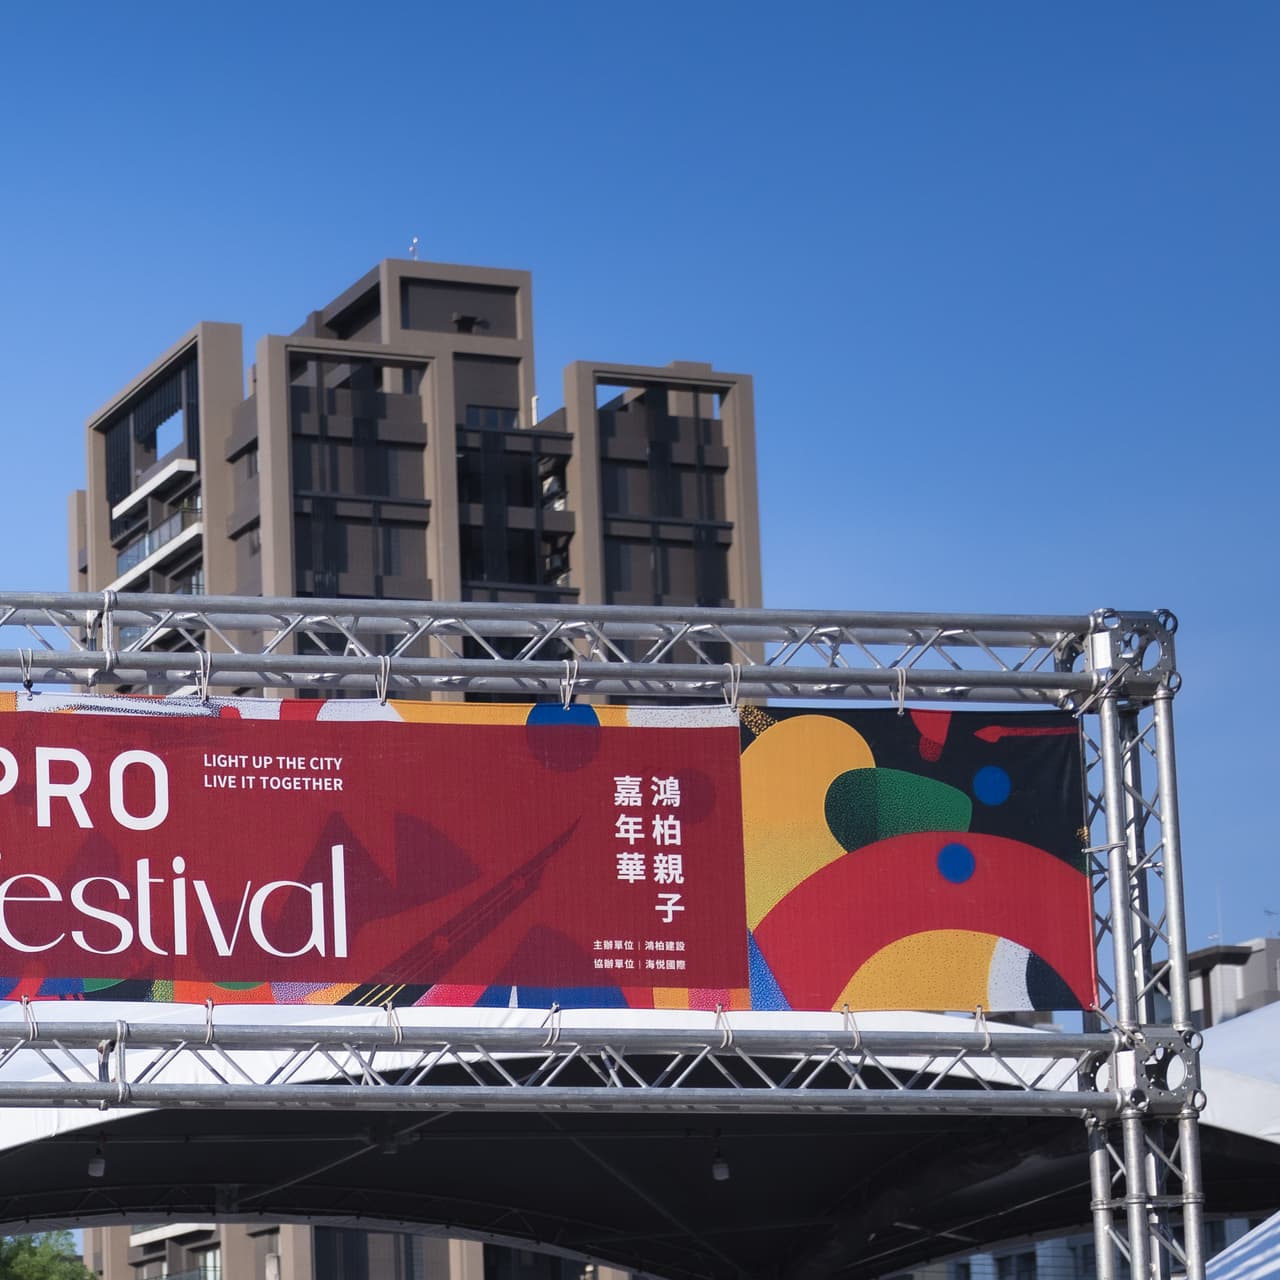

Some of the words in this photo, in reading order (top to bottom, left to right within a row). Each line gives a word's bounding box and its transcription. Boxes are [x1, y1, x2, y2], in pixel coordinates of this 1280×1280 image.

[204, 753, 248, 768] LIGHT
[252, 755, 273, 769] UP
[276, 756, 306, 769] THE
[310, 757, 342, 771] CITY
[204, 774, 237, 788] LIVE
[241, 776, 255, 789] IT
[259, 776, 344, 791] TOGETHER
[613, 775, 647, 884] 嘉年華
[651, 776, 686, 924] 鴻柏親子
